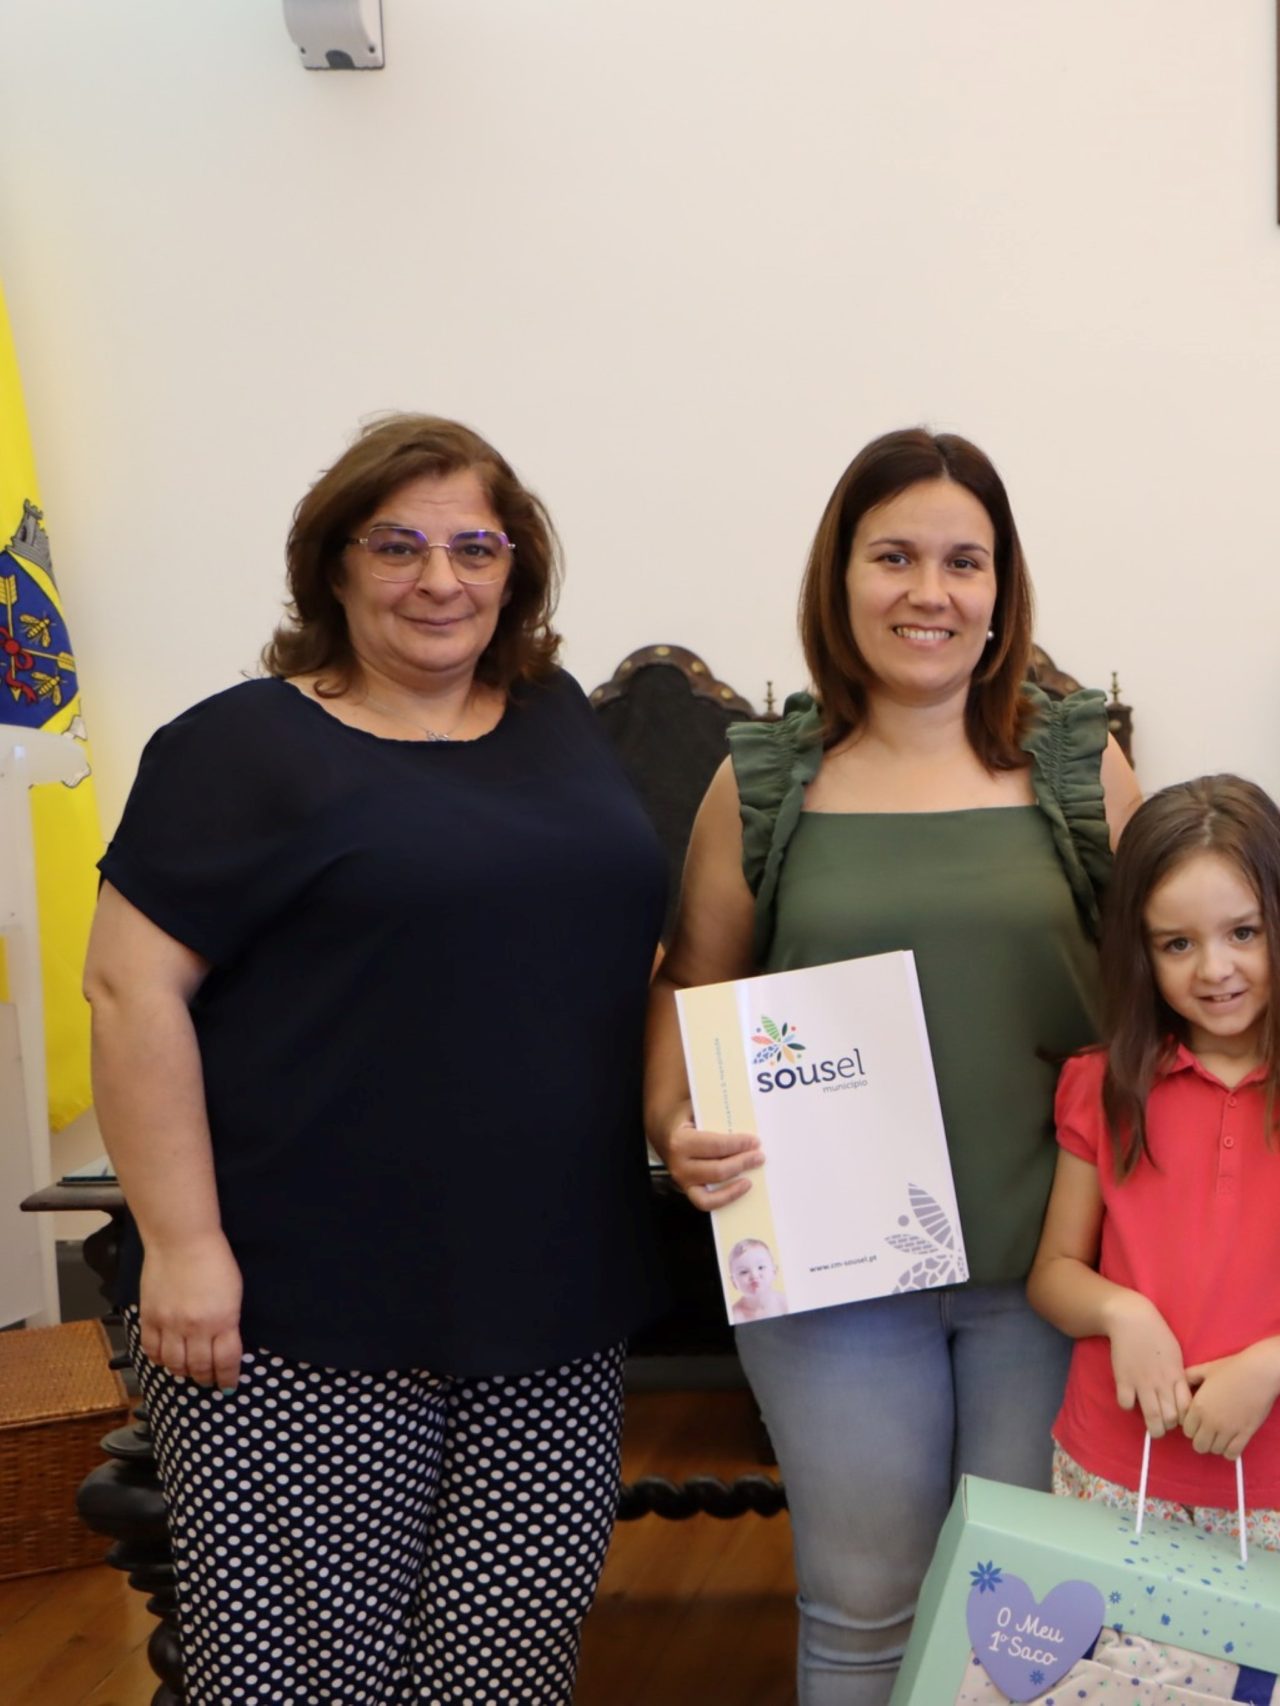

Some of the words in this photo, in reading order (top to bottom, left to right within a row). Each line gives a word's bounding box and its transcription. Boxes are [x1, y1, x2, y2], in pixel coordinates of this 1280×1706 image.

[756, 1048, 866, 1093] sousel
[997, 1606, 1012, 1628] O
[1015, 1613, 1065, 1643] Meu
[1007, 1635, 1058, 1665] Saco
